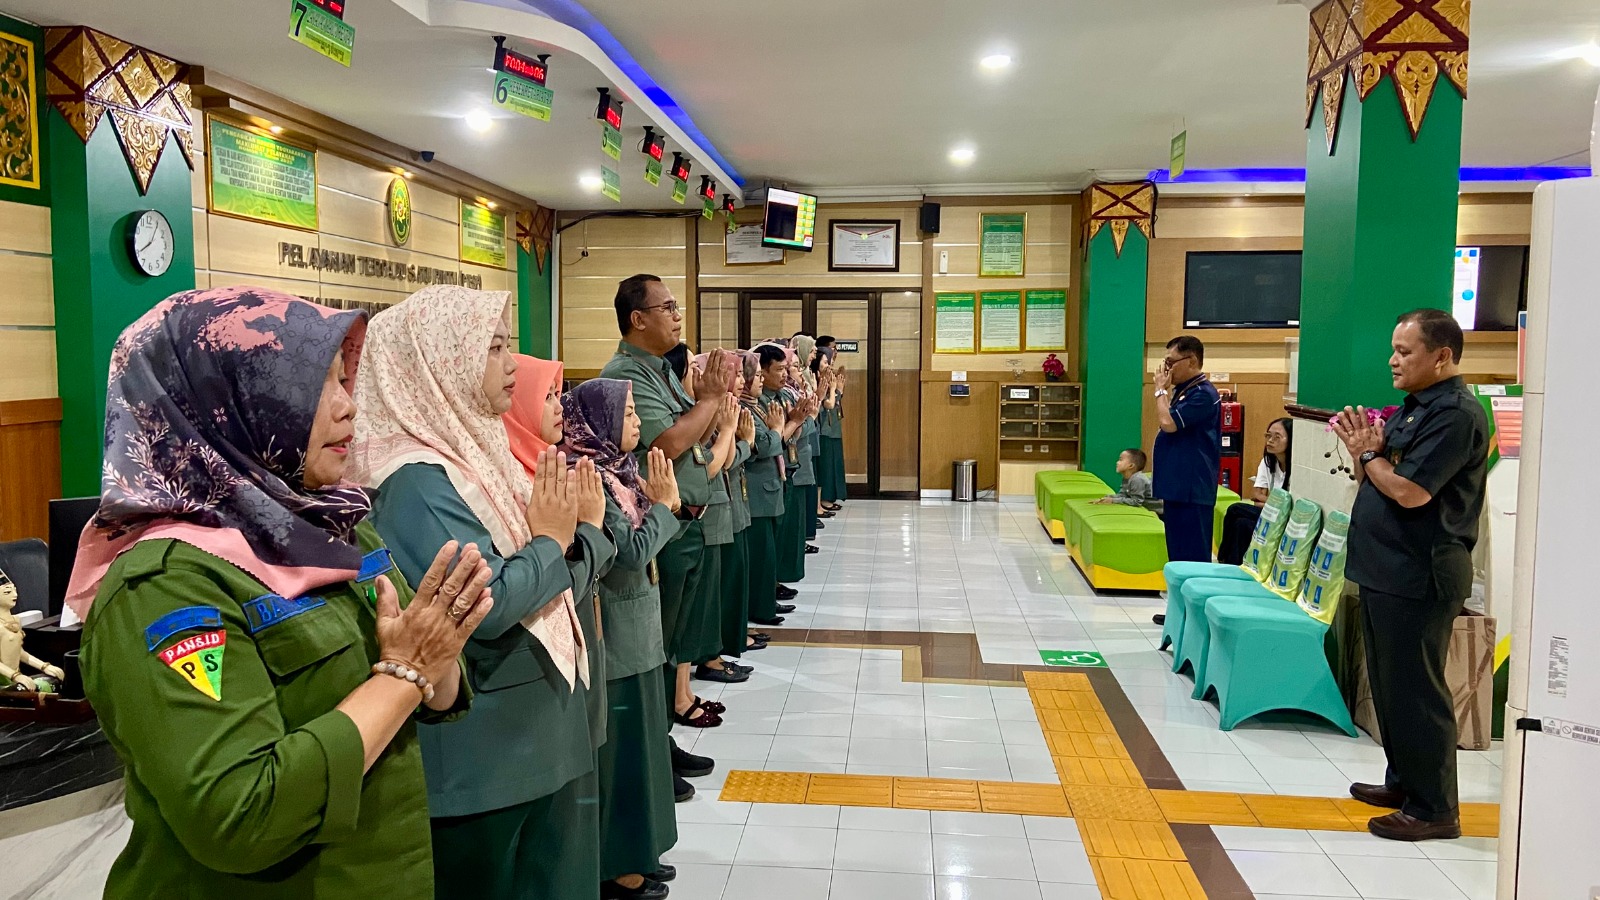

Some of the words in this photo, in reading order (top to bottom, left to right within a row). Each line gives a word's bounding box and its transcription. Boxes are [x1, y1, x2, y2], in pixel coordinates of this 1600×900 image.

[295, 1, 307, 37] 7
[496, 78, 508, 104] 6
[146, 215, 153, 225] 12
[165, 633, 220, 660] PANSID
[181, 661, 196, 680] P
[204, 653, 219, 672] S
